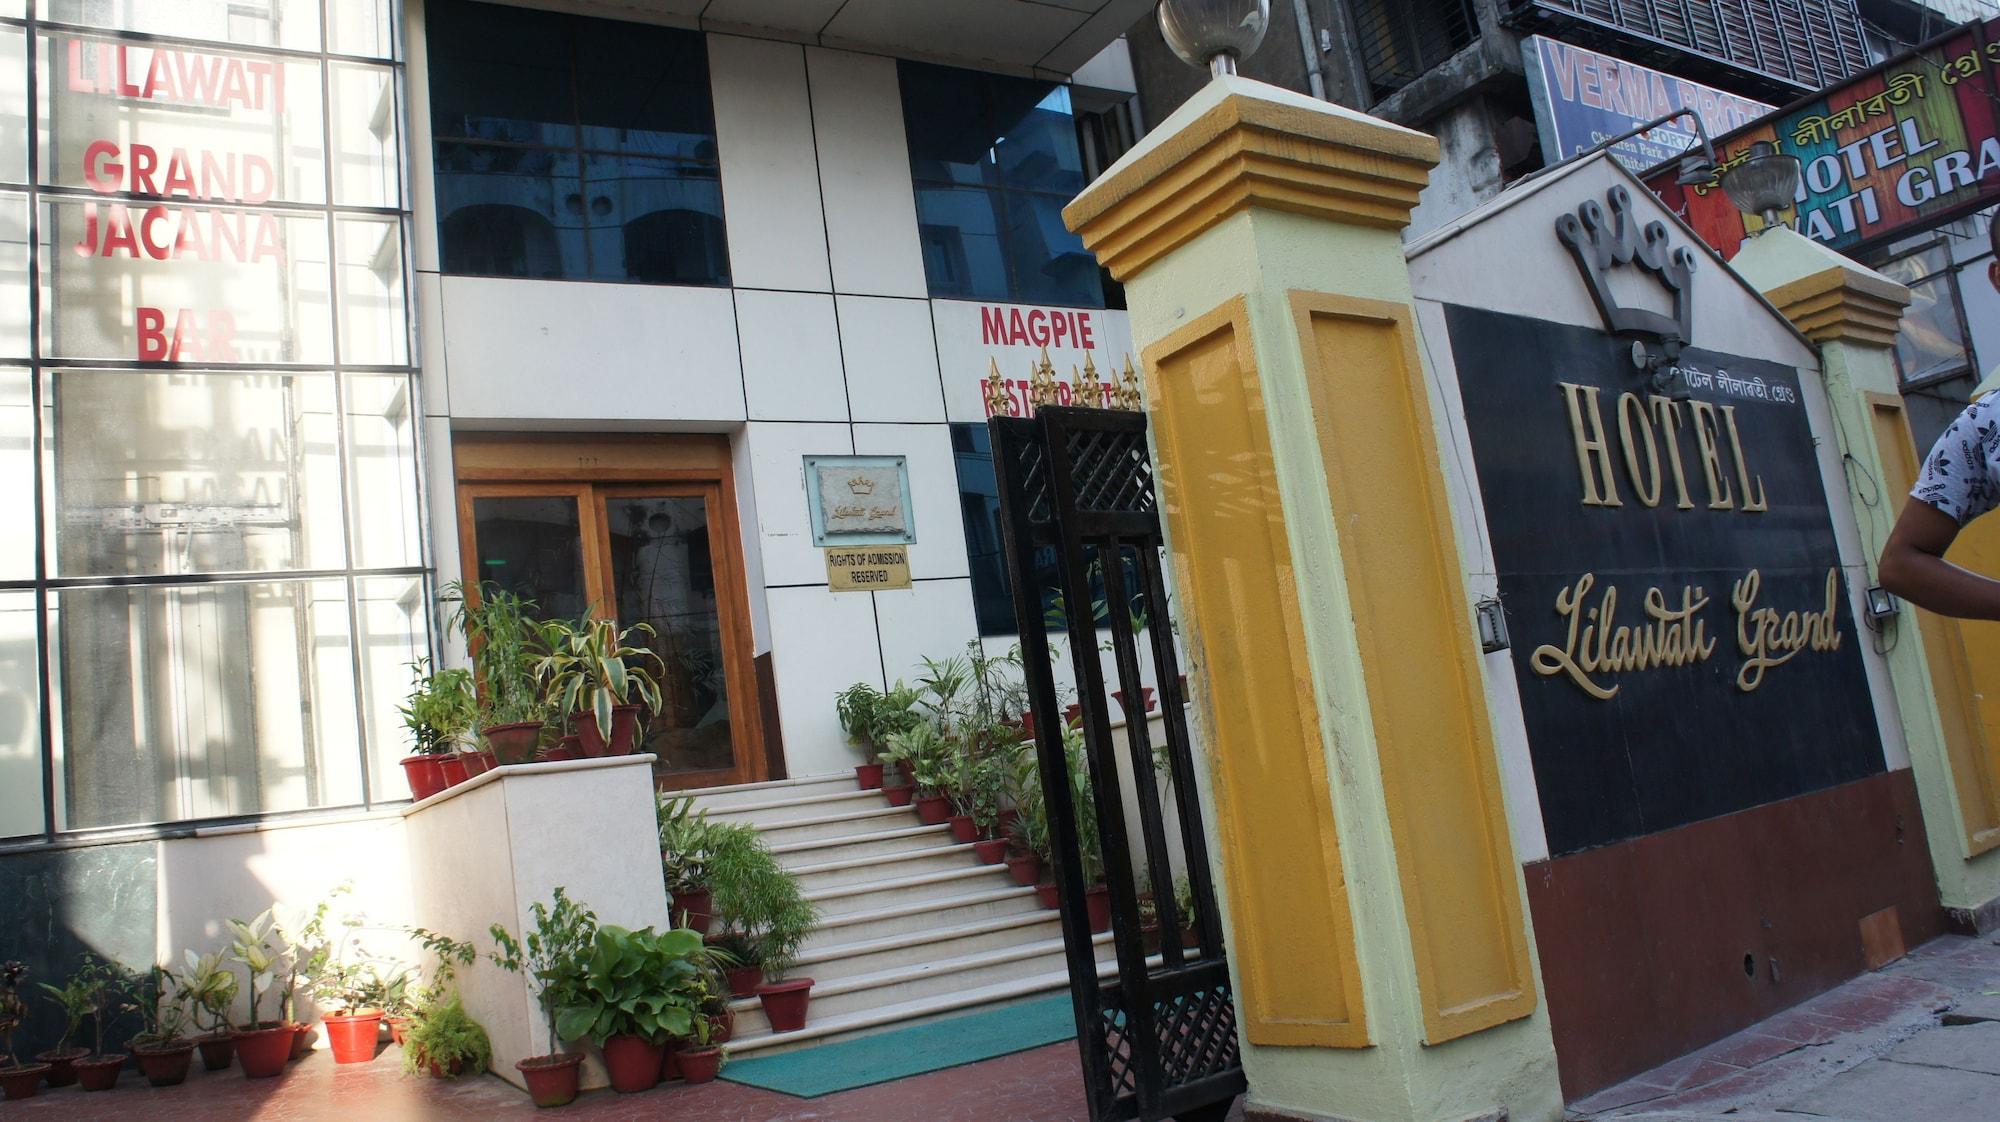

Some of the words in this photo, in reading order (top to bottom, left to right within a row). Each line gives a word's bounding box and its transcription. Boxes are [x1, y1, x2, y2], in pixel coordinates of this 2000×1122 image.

[68, 39, 286, 113] LILAWATI
[1547, 42, 1677, 127] VERMA
[83, 139, 274, 204] GRAND
[74, 202, 287, 266] JACANA
[1794, 187, 1880, 241] ATI
[136, 307, 238, 362] BAR
[981, 306, 1095, 349] MAGPIE
[1559, 381, 1768, 512] HOTEL
[829, 553, 855, 567] RIGHTS
[857, 553, 866, 566] OF
[867, 552, 905, 565] ADMISSION
[851, 570, 888, 583] RESERVED
[1530, 572, 1716, 700] Lilawati
[1732, 567, 1842, 692] Grand
